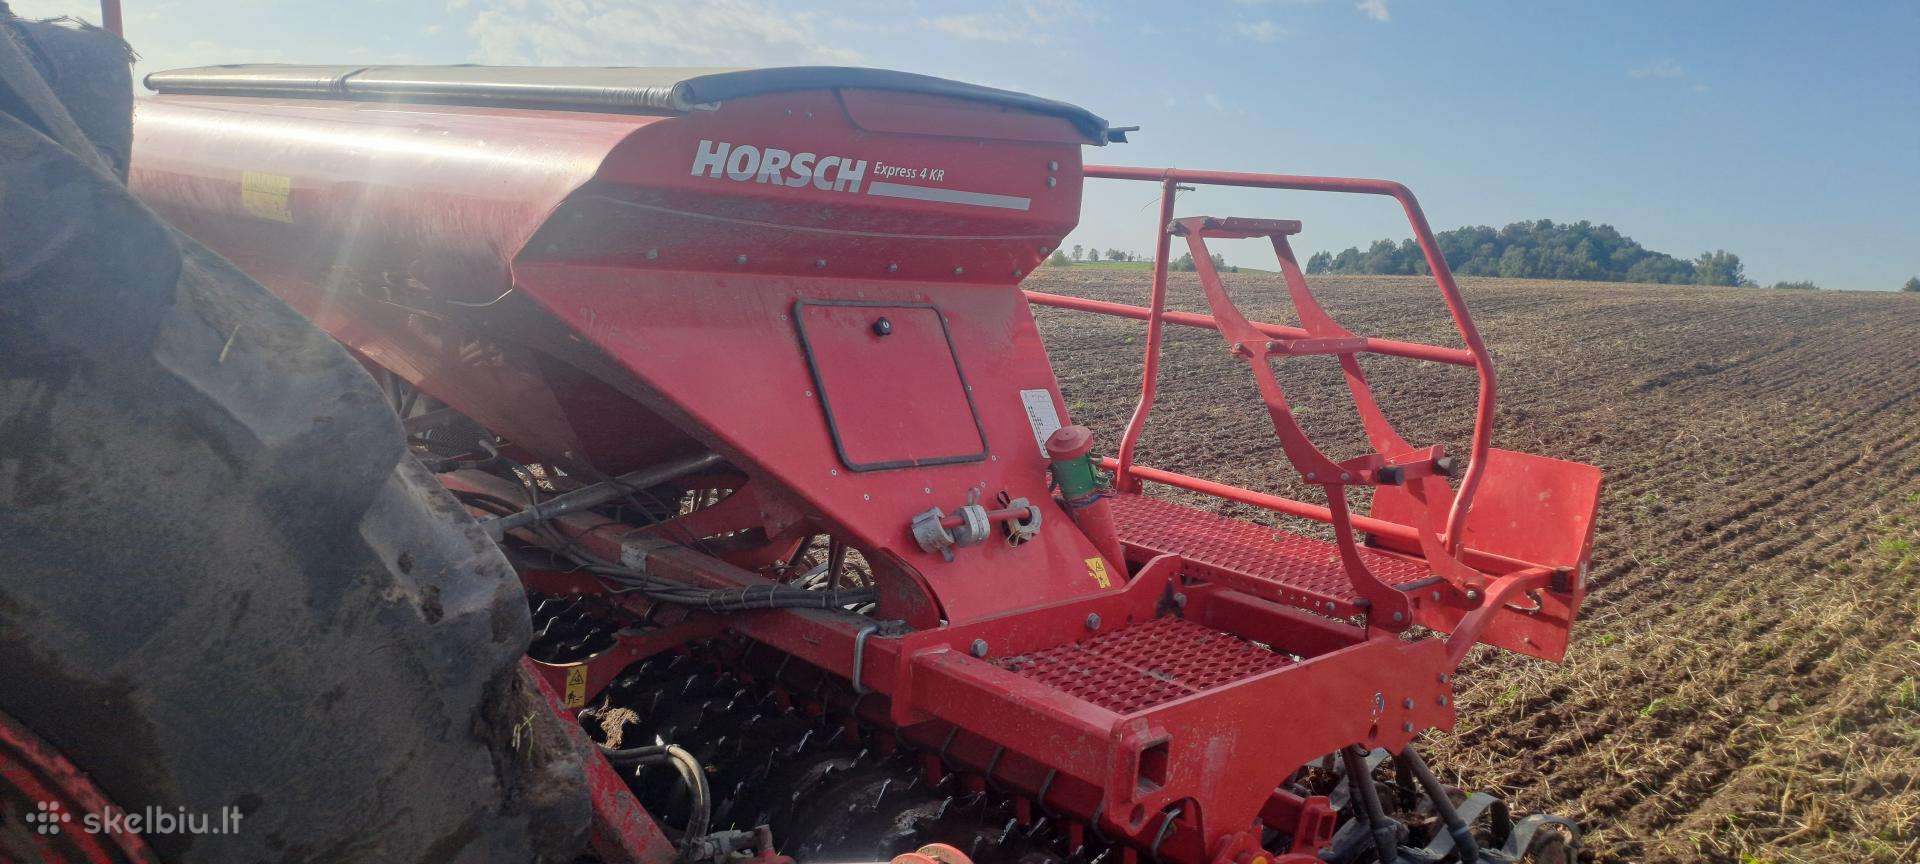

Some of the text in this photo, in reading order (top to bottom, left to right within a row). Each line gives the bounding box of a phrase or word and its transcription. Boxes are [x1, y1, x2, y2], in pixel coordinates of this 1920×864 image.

[691, 139, 867, 193] HORSCH
[873, 161, 945, 182] Express 4 KR
